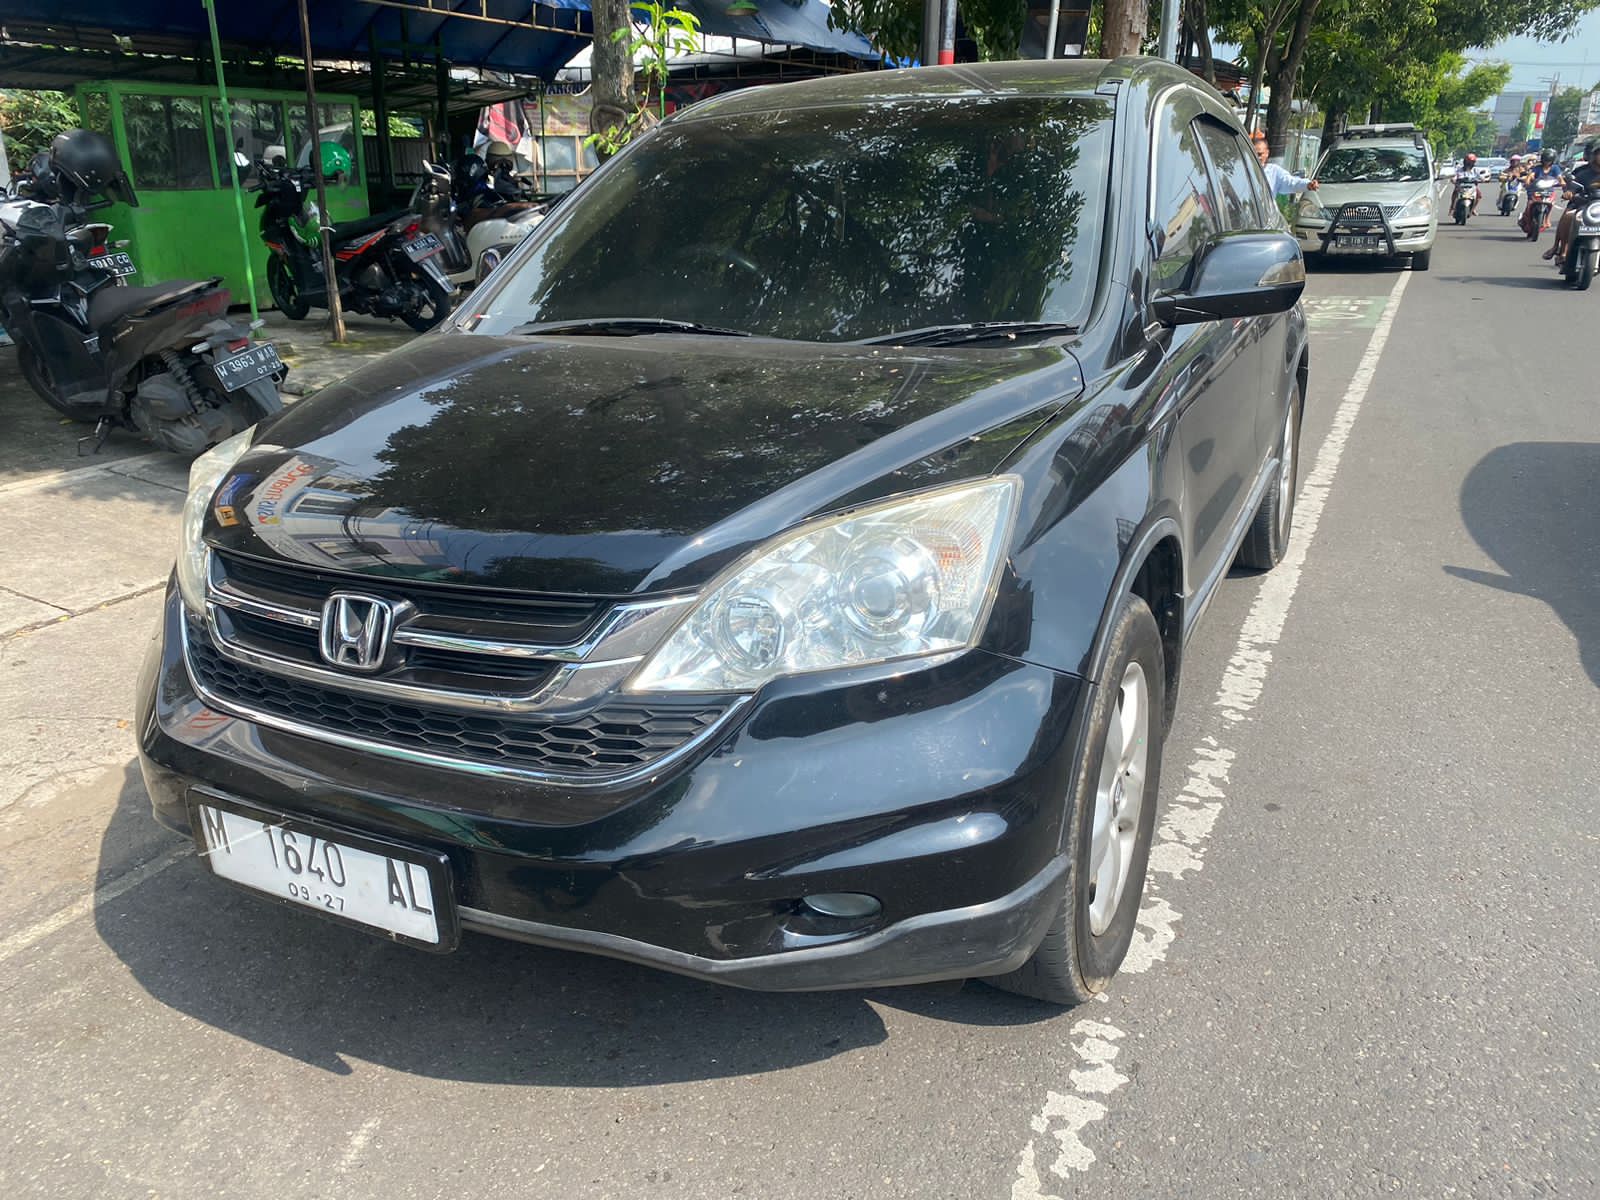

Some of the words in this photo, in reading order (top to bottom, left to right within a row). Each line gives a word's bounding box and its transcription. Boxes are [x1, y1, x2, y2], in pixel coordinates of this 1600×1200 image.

[217, 365, 229, 377] W
[229, 355, 255, 373] 3963
[262, 823, 347, 888] 1640
[386, 857, 433, 915] AL
